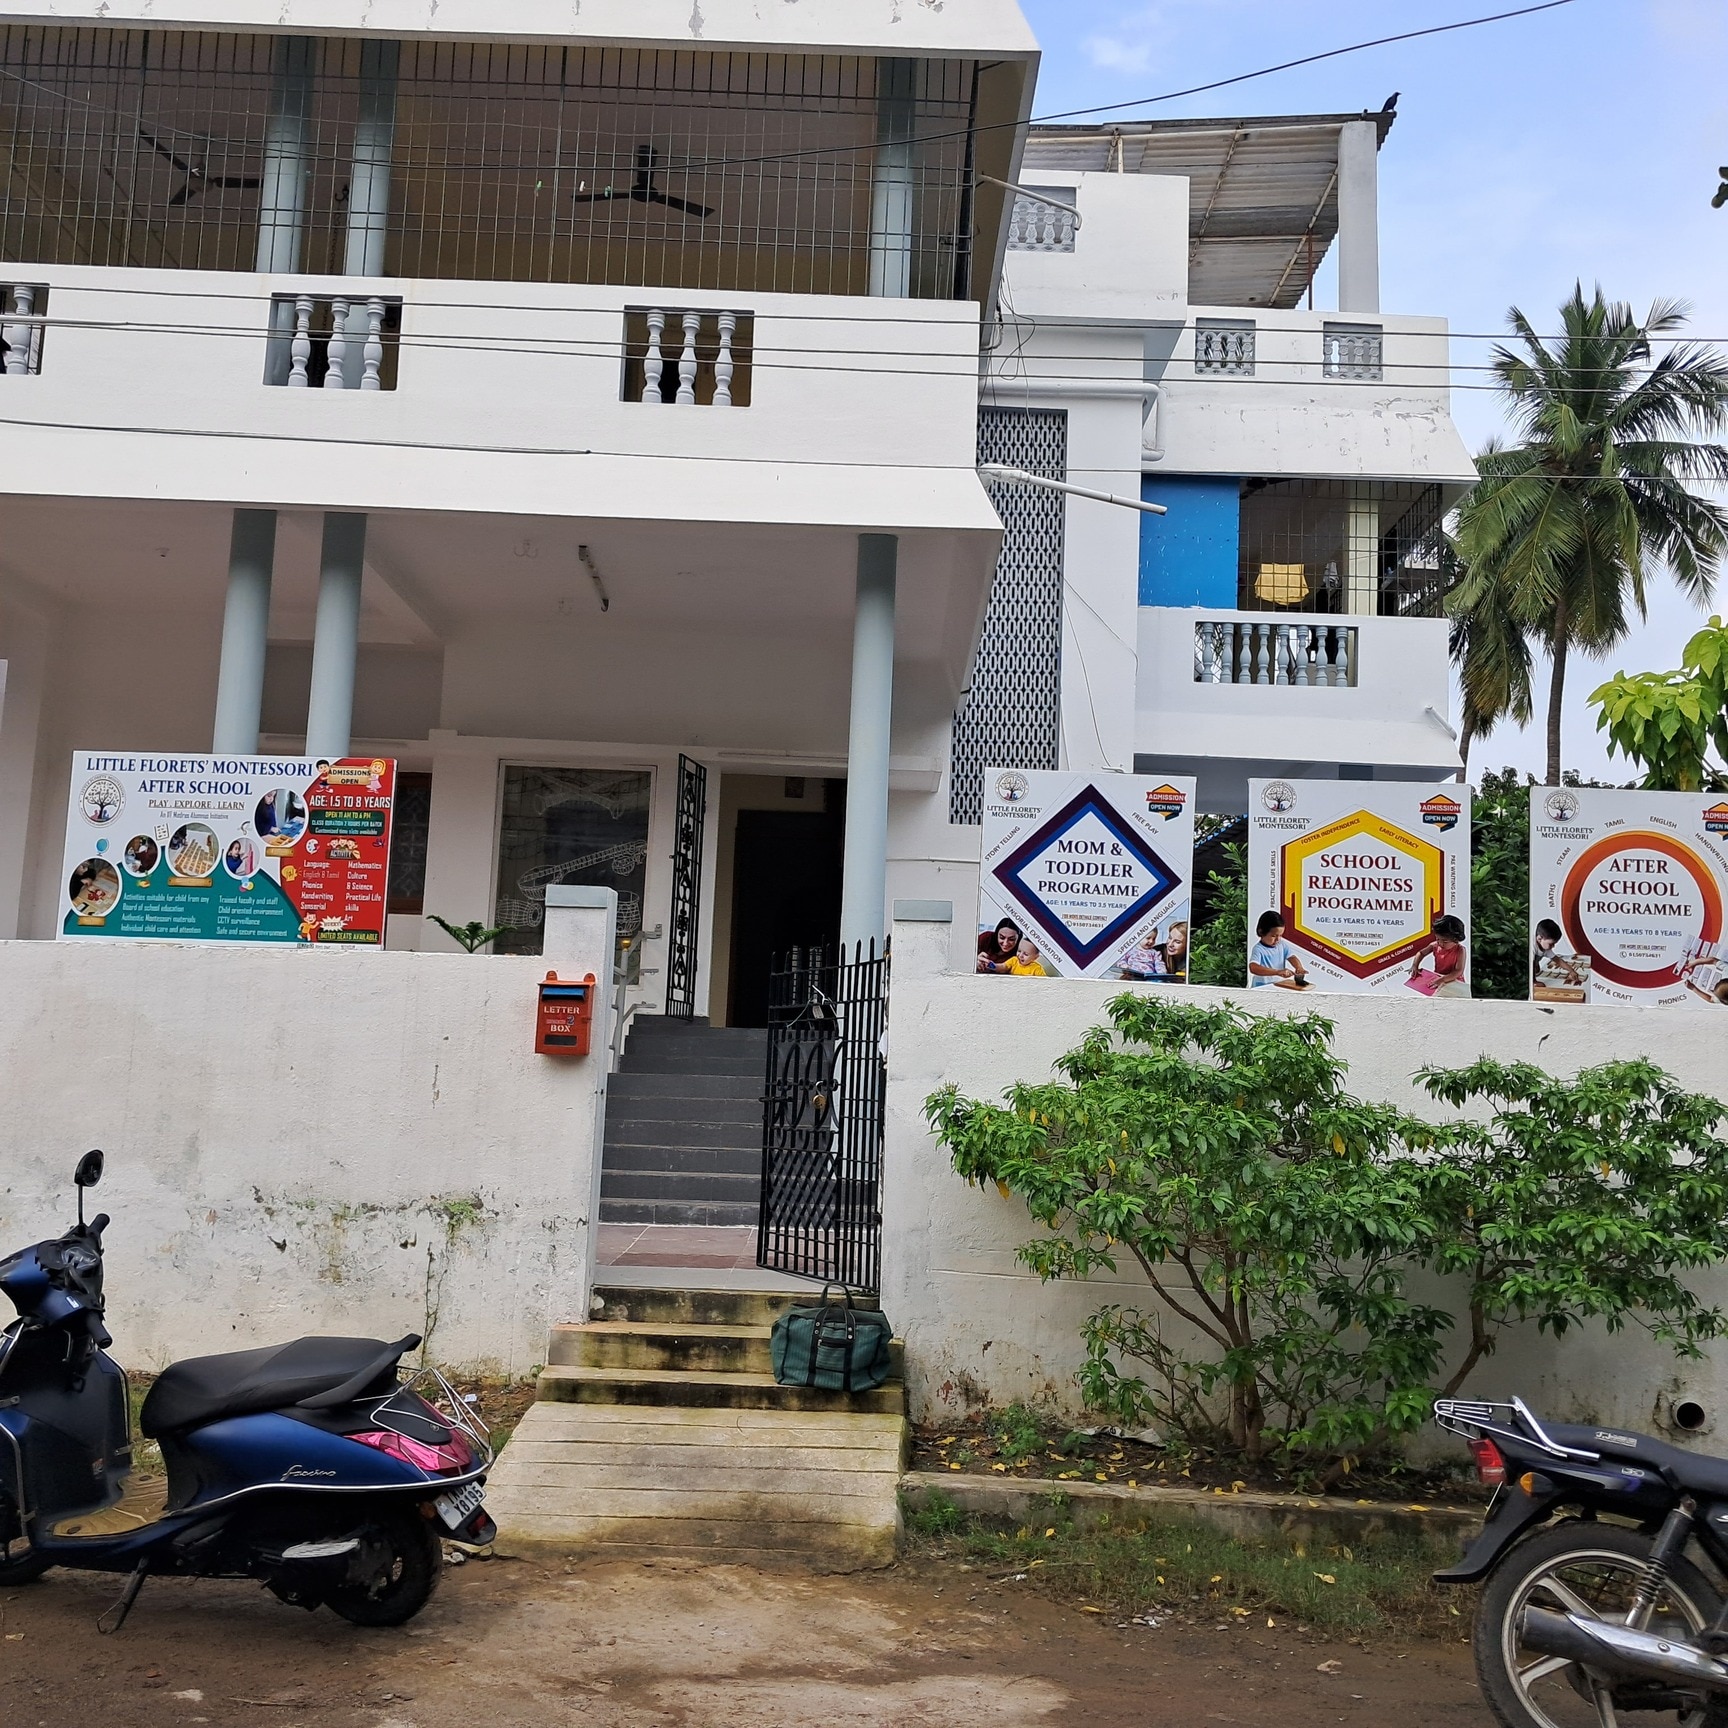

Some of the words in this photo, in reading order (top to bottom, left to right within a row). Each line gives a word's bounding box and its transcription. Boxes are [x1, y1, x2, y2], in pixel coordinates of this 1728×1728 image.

[87, 757, 136, 771] LITTLE
[140, 758, 209, 773] FLORETS'
[212, 760, 313, 777] MONTESSORI
[138, 780, 185, 793] AFTER
[188, 781, 252, 795] SCHOOL
[149, 799, 169, 807] PLAY
[174, 800, 211, 808] EXPLORE
[217, 801, 245, 810] LEARN
[309, 795, 328, 806] AGE:
[330, 795, 341, 806] 1.5
[343, 796, 353, 807] TO
[355, 796, 361, 808] 8
[364, 796, 391, 808] YEARS
[1148, 793, 1184, 801] ADMISSION
[1131, 811, 1145, 825] FREE
[1144, 823, 1159, 835] PLAY
[1604, 818, 1625, 828] TAMIL
[1650, 816, 1677, 829] ENGLISH
[1301, 834, 1321, 845] FOSTER
[1320, 818, 1361, 837] INDEPENDENCE
[1379, 826, 1395, 836] EARLY
[1395, 834, 1419, 849] LITERACY
[984, 845, 1001, 861] STORY
[999, 825, 1020, 846] TELLING
[1057, 840, 1106, 855] MOM
[1110, 843, 1123, 856] &
[330, 850, 352, 858] ACTIVITY
[1556, 847, 1571, 866] STEAM
[1695, 832, 1728, 873] HANDWRITING
[348, 861, 382, 869] Mathematics
[1045, 861, 1134, 878] TODDLER
[1320, 854, 1401, 870] SCHOOL
[1609, 859, 1669, 874] AFTER
[347, 871, 368, 880] Culture
[302, 880, 323, 888] Phonics
[346, 882, 351, 890] &
[352, 882, 373, 890] Science
[1038, 881, 1140, 897] PROGRAMME
[1308, 875, 1413, 893] READINESS
[1599, 880, 1679, 896] SCHOOL
[301, 891, 334, 901] Handwriting
[371, 893, 382, 901] Life
[1307, 895, 1413, 912] PROGRAMME
[1548, 883, 1556, 908] MATHS
[1586, 901, 1692, 917] PROGRAMME
[1003, 903, 1031, 931] SENSORIAL
[1029, 929, 1063, 964] EXPLORATION
[1117, 935, 1137, 955] SPEECH
[1136, 924, 1149, 937] AND
[1148, 899, 1177, 925] LANGUAGE
[318, 932, 336, 940] LIMITED
[337, 932, 352, 940] SEATS
[1309, 960, 1321, 969] ART
[1326, 969, 1344, 980] CRAFT
[1370, 976, 1386, 987] EARLY
[1385, 966, 1405, 979] MATHS
[1592, 982, 1606, 992] ART
[1612, 991, 1633, 1002] CRAFT
[1658, 994, 1687, 1005] PHONICS
[544, 1006, 580, 1015] LETTER
[550, 1024, 571, 1032] BOX
[454, 1486, 484, 1518] X8195
